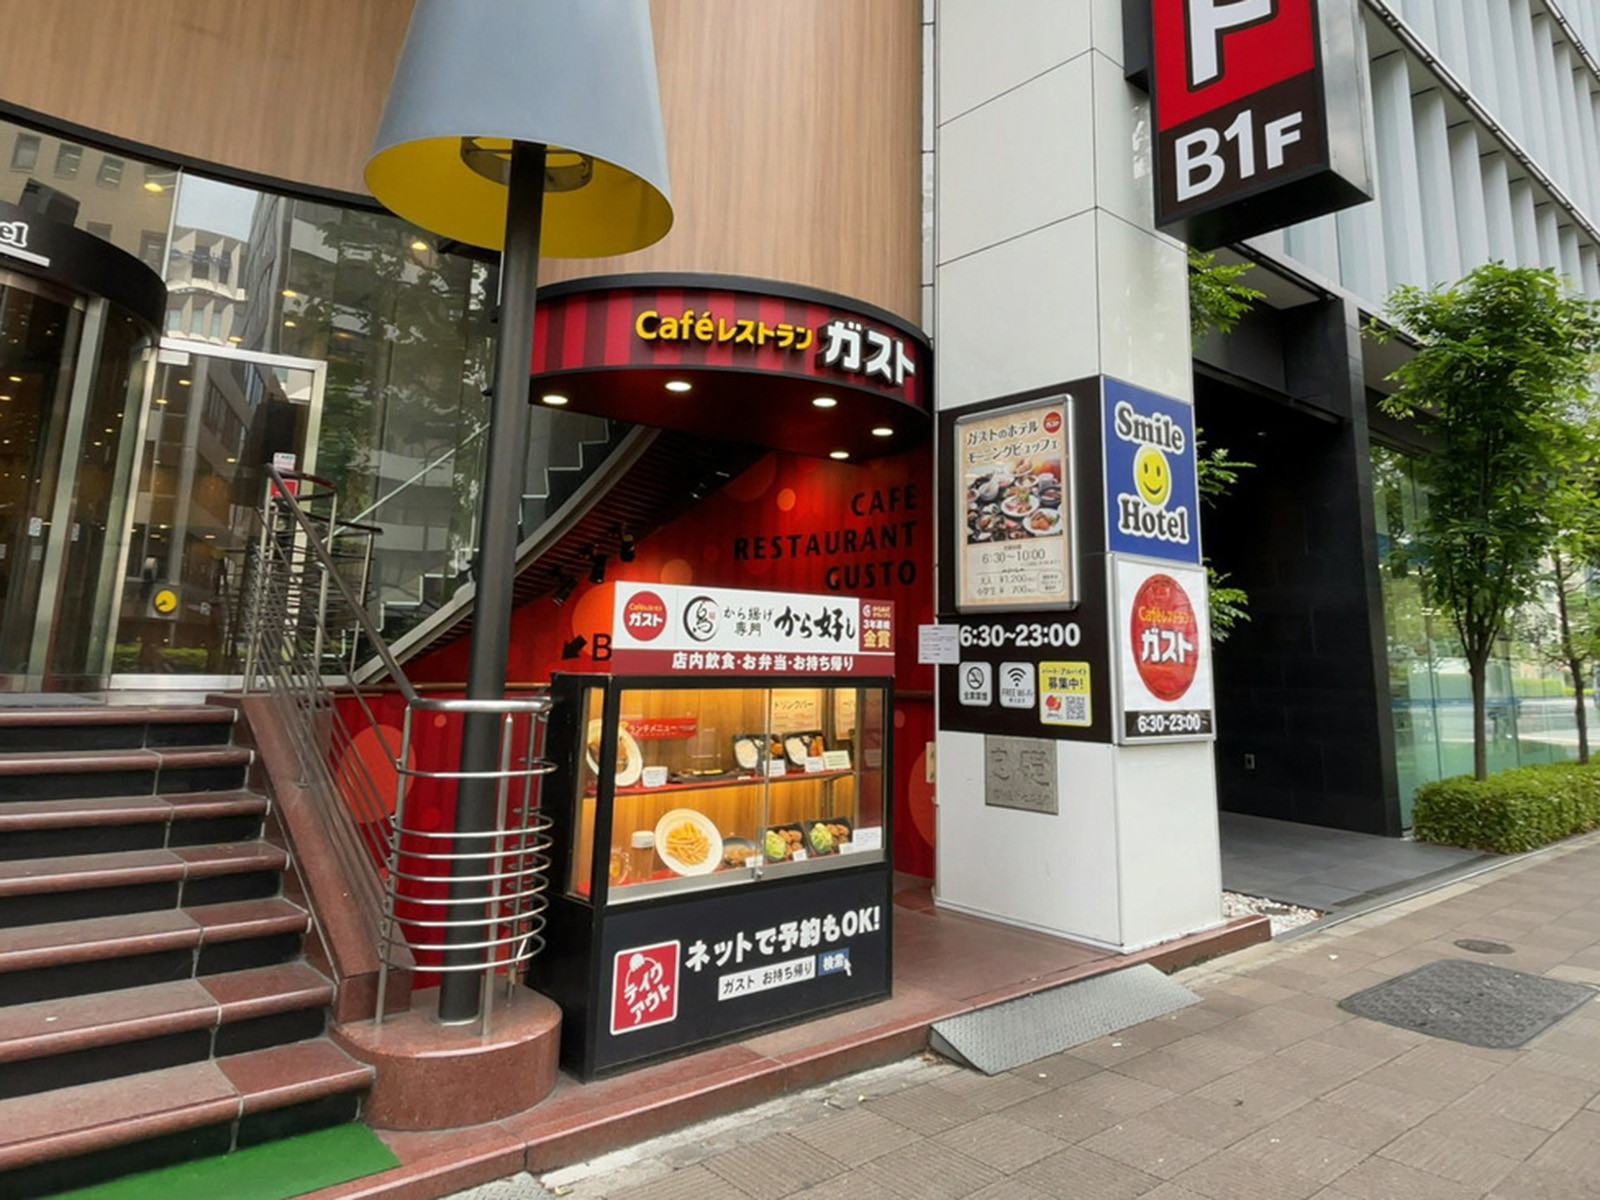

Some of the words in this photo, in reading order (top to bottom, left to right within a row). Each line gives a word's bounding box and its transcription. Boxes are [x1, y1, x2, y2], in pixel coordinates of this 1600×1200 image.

[1174, 109, 1303, 202] B1F
[825, 319, 915, 386] ガスト
[968, 420, 1038, 446] ガストのホテル
[1115, 402, 1184, 454] Smile
[851, 484, 917, 517] CAFE
[1118, 494, 1189, 543] Hotel
[733, 521, 917, 561] RESTAURANT
[826, 559, 917, 590] GUSTO
[629, 612, 663, 627] ガスト
[723, 607, 774, 622] から揚げ
[774, 605, 856, 642] から好し
[1141, 626, 1193, 664] ガスト
[685, 905, 881, 973] ネットで予約もOK!
[723, 974, 755, 995] ガスト
[762, 961, 813, 986] お持ち帰り
